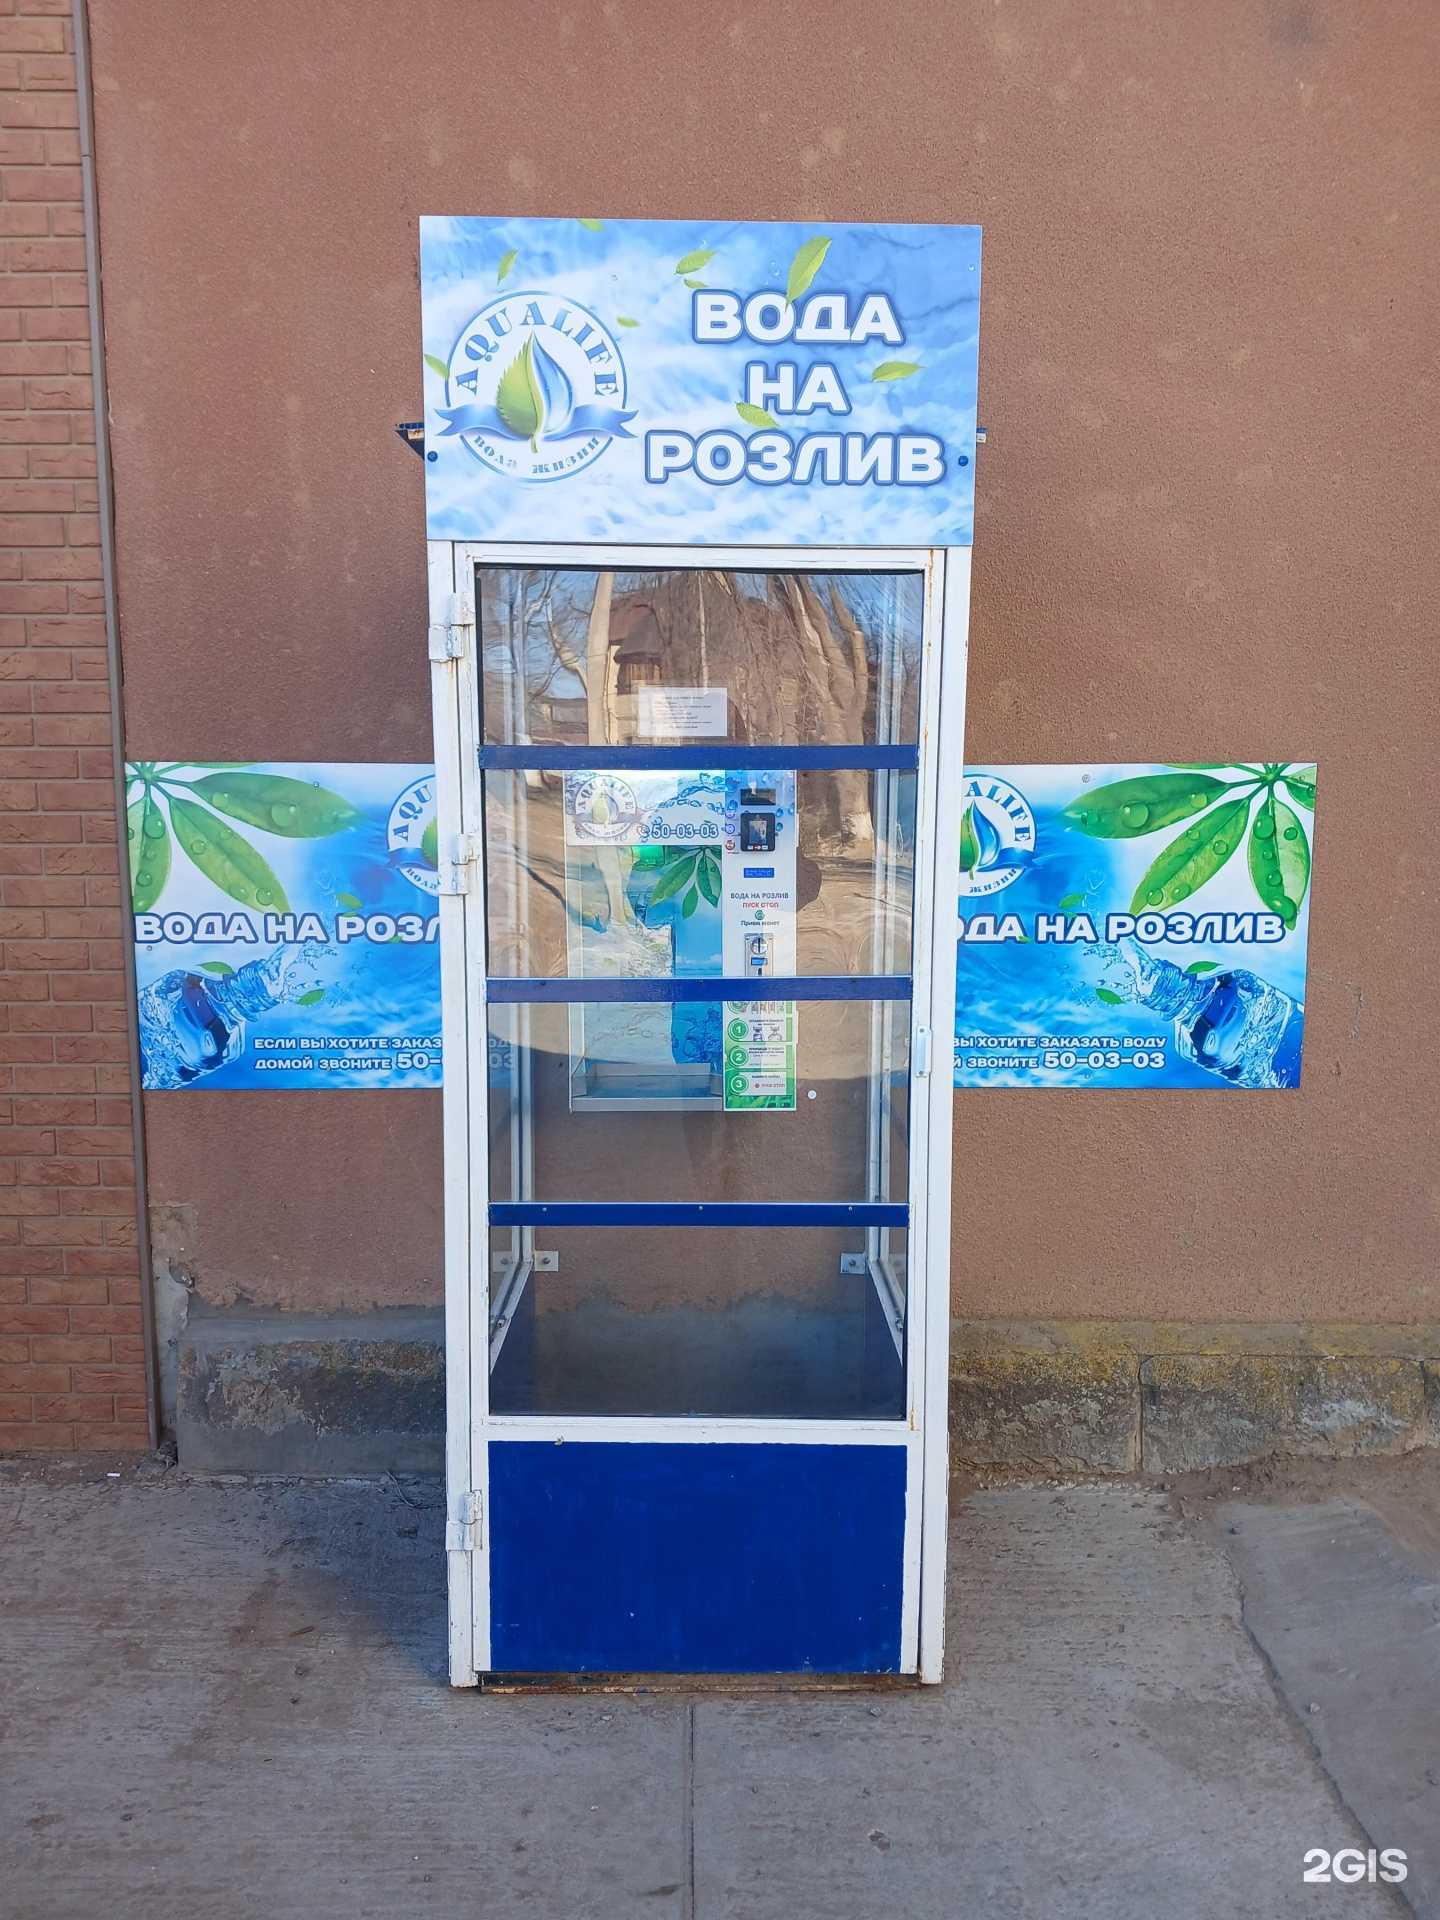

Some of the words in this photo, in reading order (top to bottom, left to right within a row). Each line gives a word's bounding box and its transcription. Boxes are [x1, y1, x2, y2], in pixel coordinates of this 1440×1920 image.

[694, 291, 904, 343] ВОДА
[456, 301, 619, 397] AQUALIFE
[746, 362, 850, 414] НА
[645, 430, 946, 485] РОЗЛИВ
[964, 781, 1032, 842] ALIFE
[652, 824, 719, 839] 50-03-03
[135, 914, 257, 943] ВОДА
[265, 914, 327, 943] НА
[337, 914, 441, 943] РОЗЛ
[958, 914, 1028, 943] ДА
[1036, 914, 1099, 943] НА
[1105, 913, 1286, 943] РОЗЛИВ
[254, 1038, 297, 1049] ЕСЛИ
[300, 1038, 325, 1049] ВЫ
[328, 1038, 388, 1049] ХОТИТЕ
[391, 1038, 442, 1049] ЗАКАЗ
[977, 1037, 1037, 1049] ХОТИТЕ
[1040, 1037, 1120, 1049] ЗАКАЗАТЬ
[1123, 1037, 1167, 1049] ВОДУ
[255, 1056, 313, 1070] ДОМОЙ
[319, 1058, 392, 1070] ЗВОНИТЕ
[967, 1056, 1039, 1069] ЗВОНИТЕ
[1044, 1051, 1166, 1069] 50-03-03
